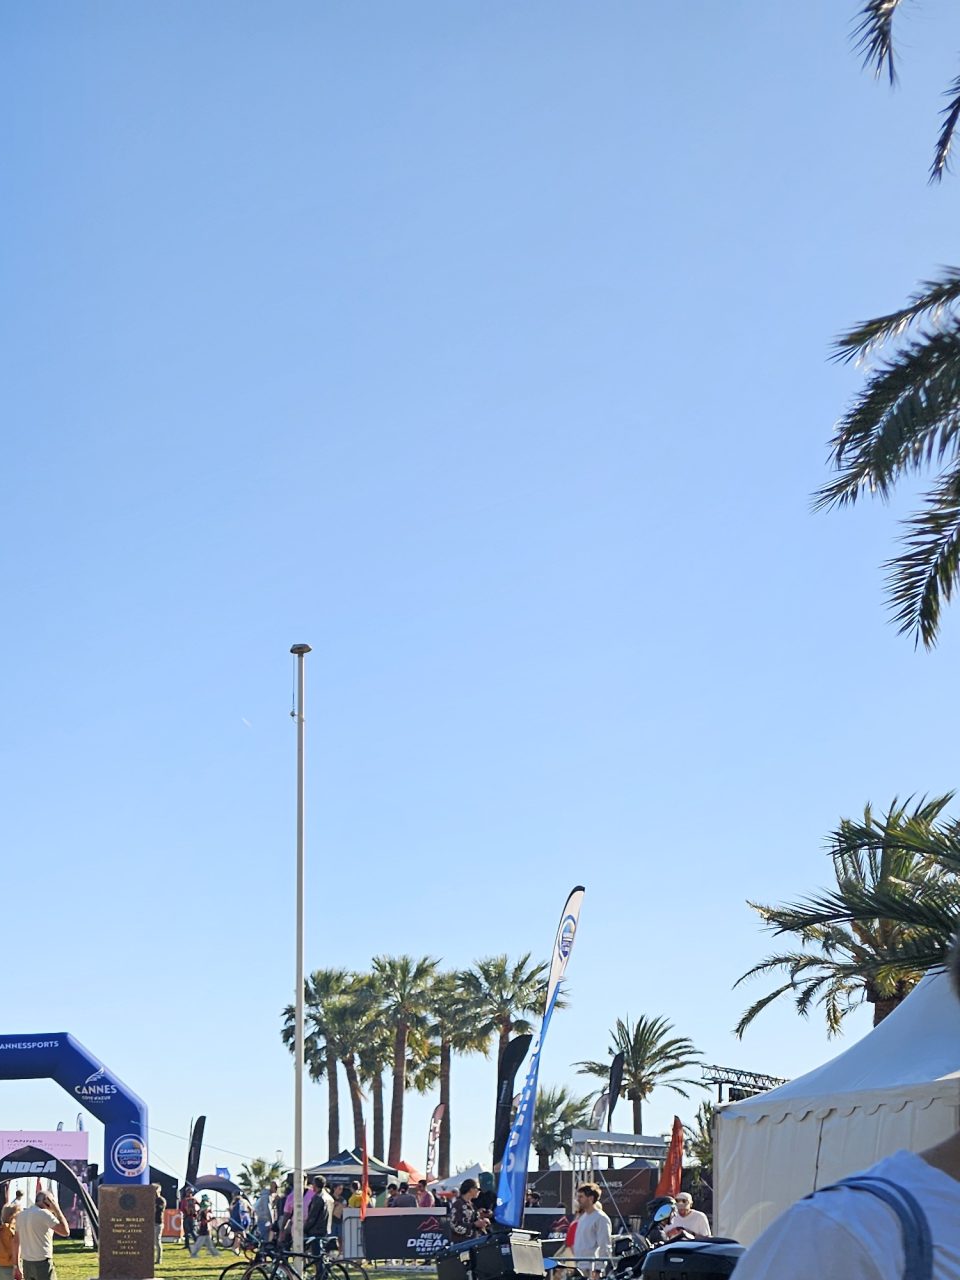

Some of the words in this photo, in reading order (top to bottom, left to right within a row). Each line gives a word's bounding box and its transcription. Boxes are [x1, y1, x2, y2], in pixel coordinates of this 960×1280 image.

[74, 1084, 117, 1095] CANNES
[0, 1160, 57, 1173] NDCA
[420, 1232, 443, 1240] NEW
